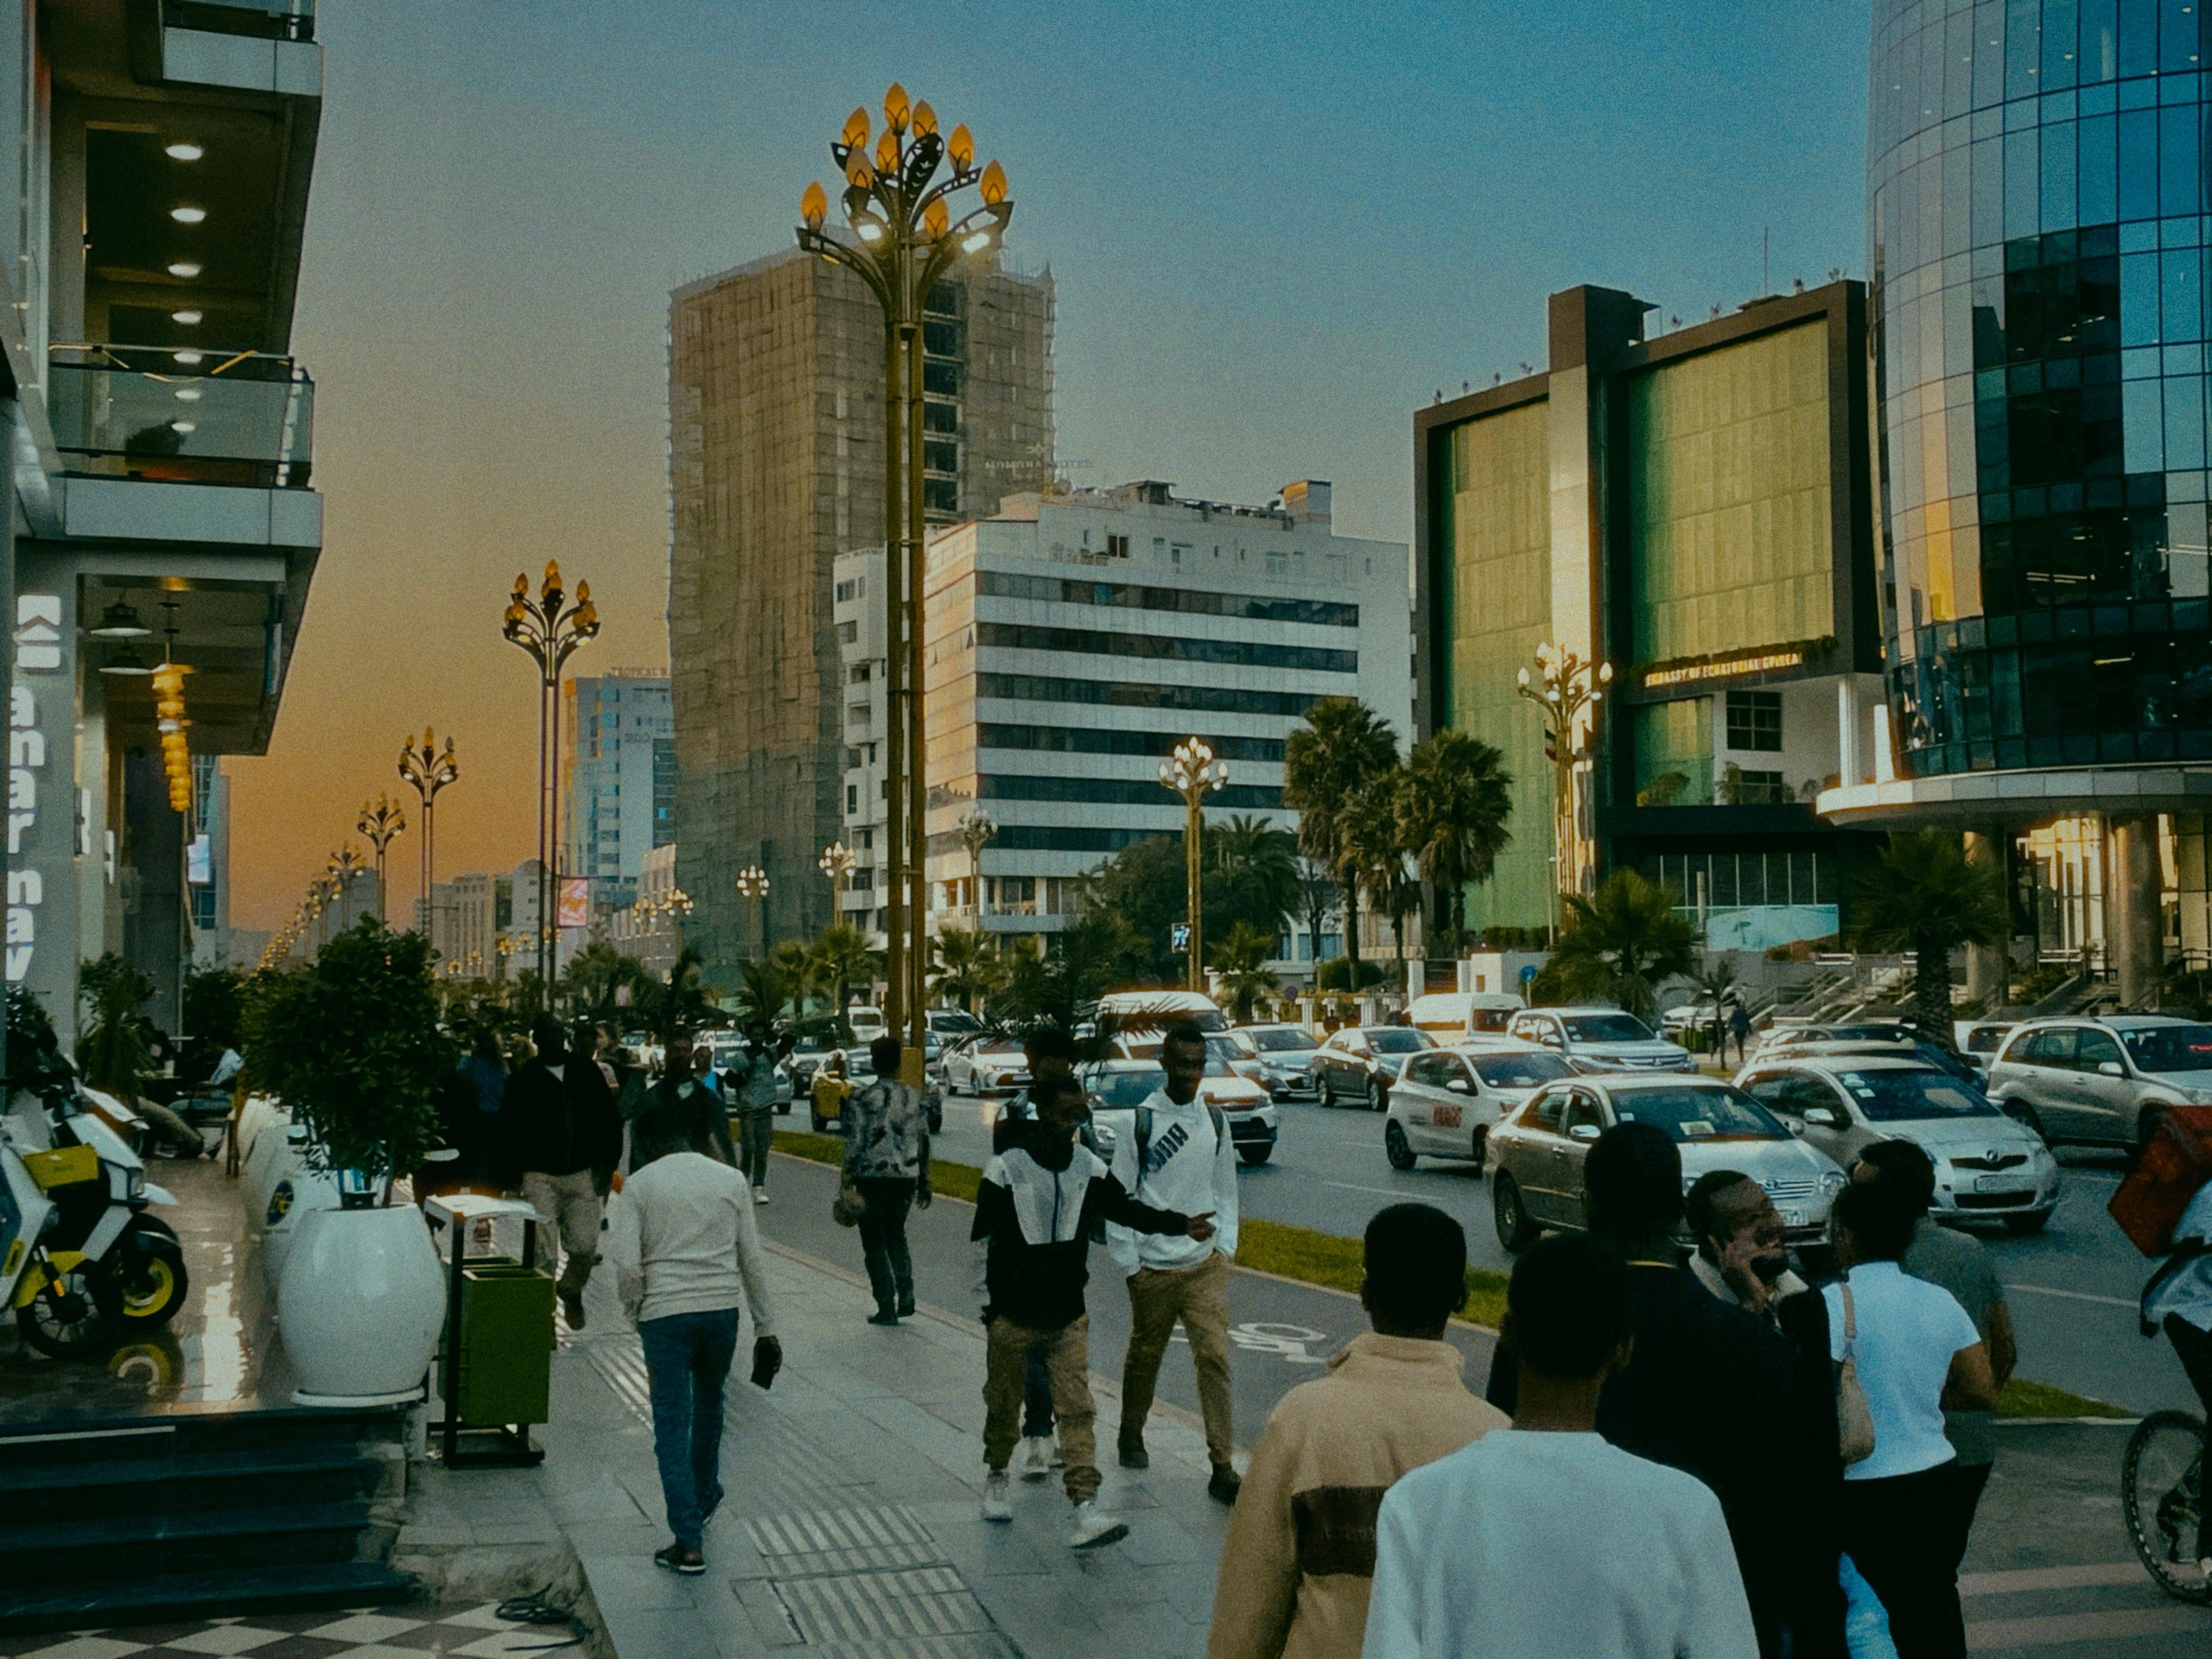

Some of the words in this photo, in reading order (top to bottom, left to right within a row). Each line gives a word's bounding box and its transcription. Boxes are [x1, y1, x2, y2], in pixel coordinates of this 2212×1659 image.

[1645, 669, 1688, 688] EMBASSY
[1689, 665, 1701, 680] OF
[1702, 658, 1760, 678] EQUATORIAL
[1763, 652, 1799, 670] GUINEA
